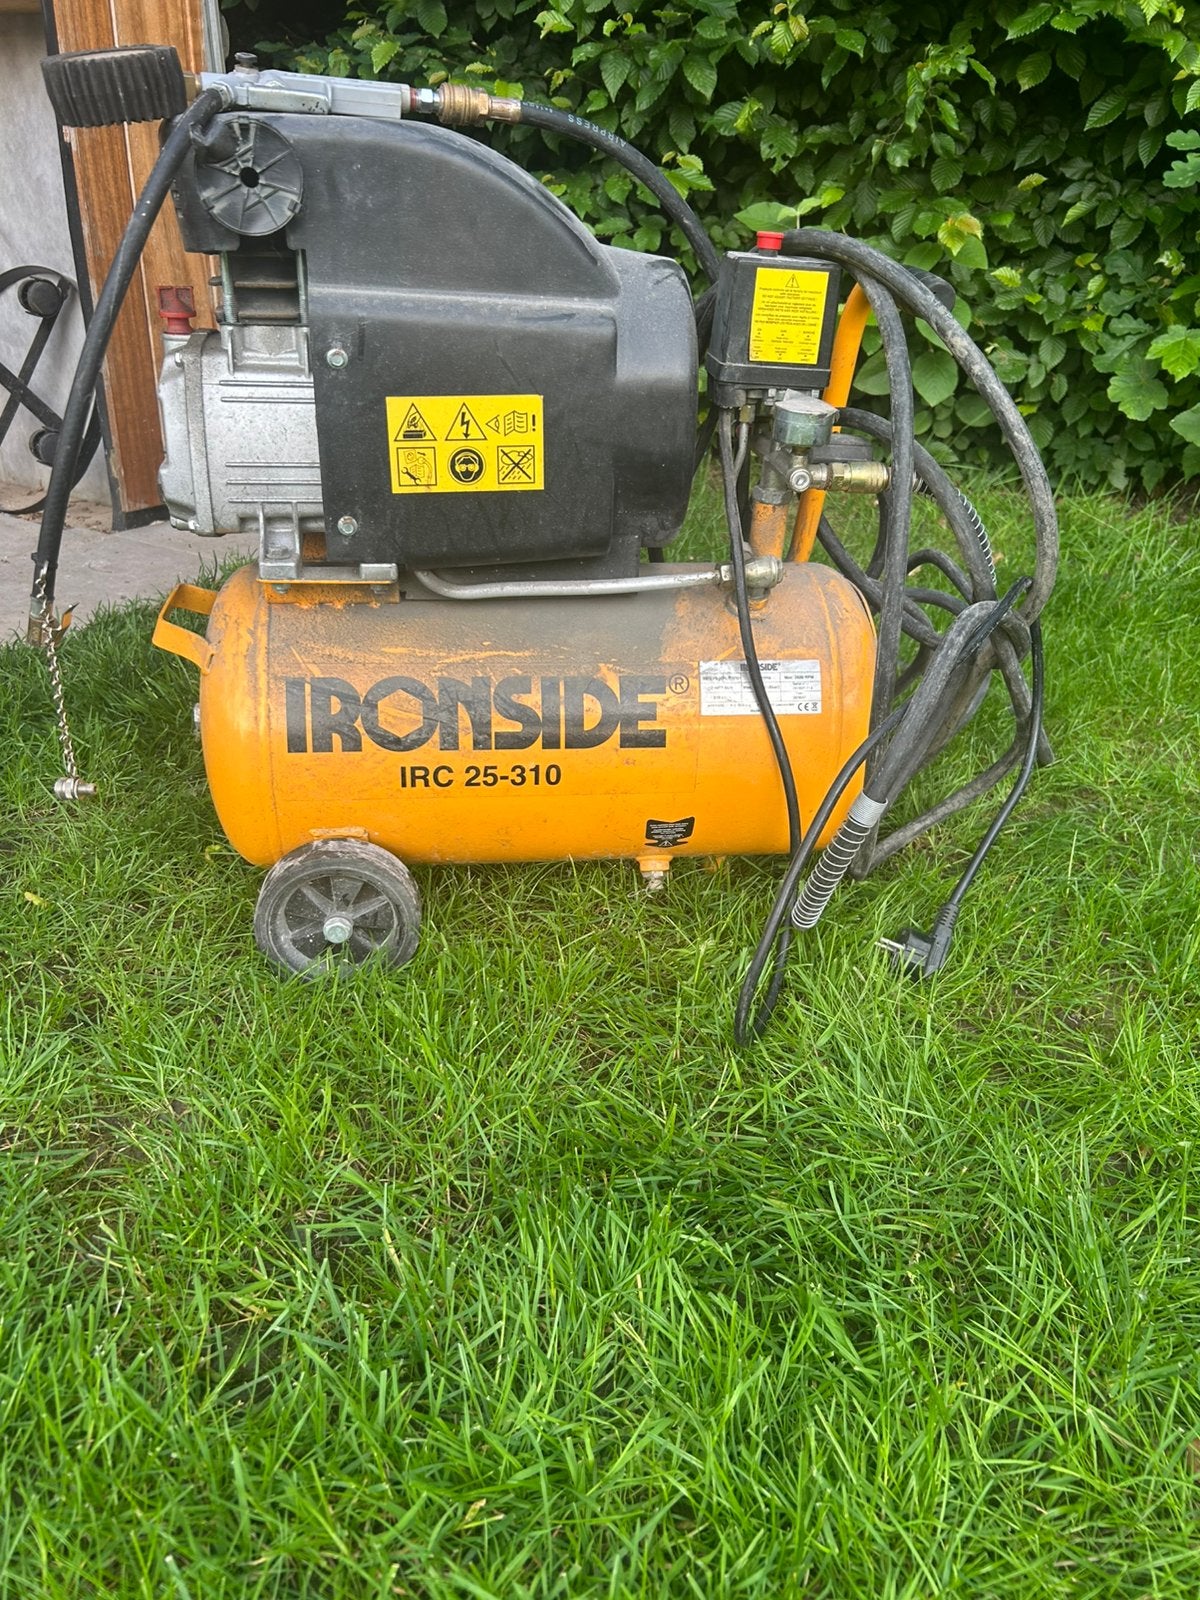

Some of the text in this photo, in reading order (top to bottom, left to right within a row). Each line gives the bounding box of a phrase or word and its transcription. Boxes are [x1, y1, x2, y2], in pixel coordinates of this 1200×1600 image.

[567, 113, 627, 147] AIRPRESS
[401, 763, 562, 788] IRC 25-310
